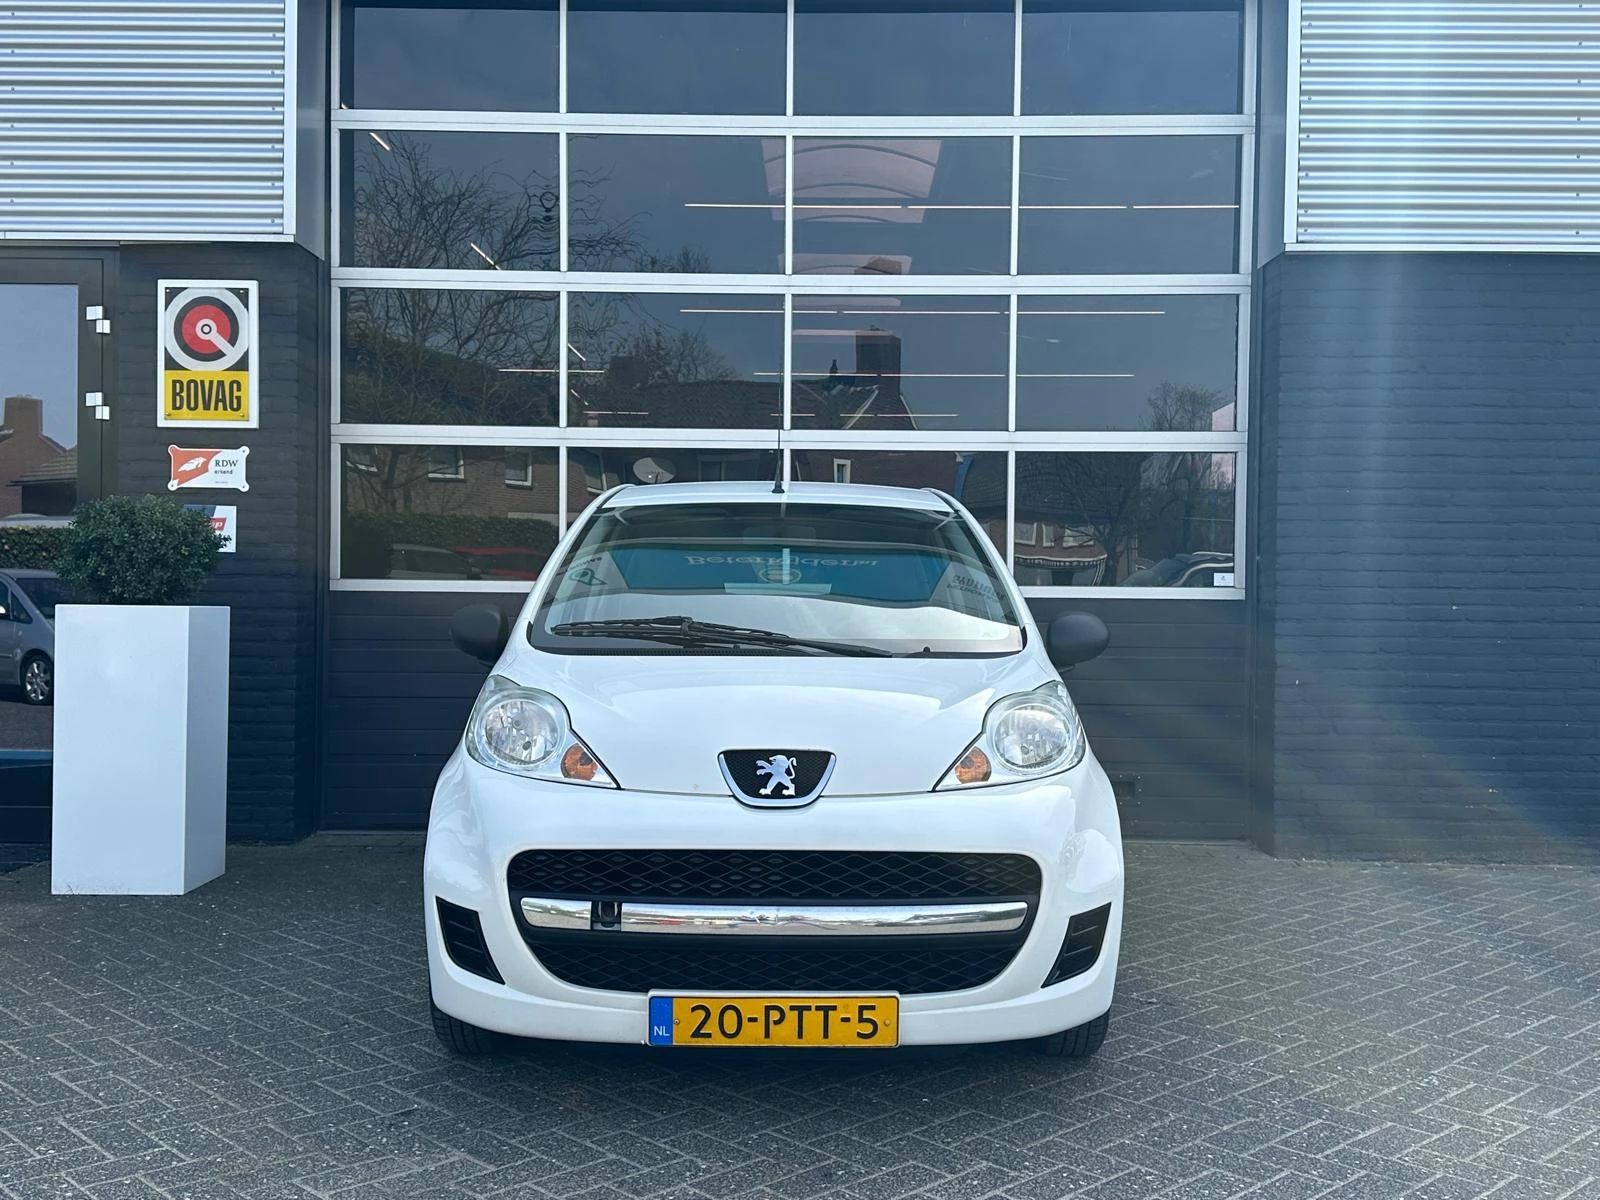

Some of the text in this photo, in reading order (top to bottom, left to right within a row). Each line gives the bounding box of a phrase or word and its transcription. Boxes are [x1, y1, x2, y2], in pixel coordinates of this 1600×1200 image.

[171, 379, 242, 412] BOVAG
[215, 459, 238, 467] RDW
[653, 1026, 670, 1037] NL
[690, 1004, 879, 1039] 20-PTT-5
